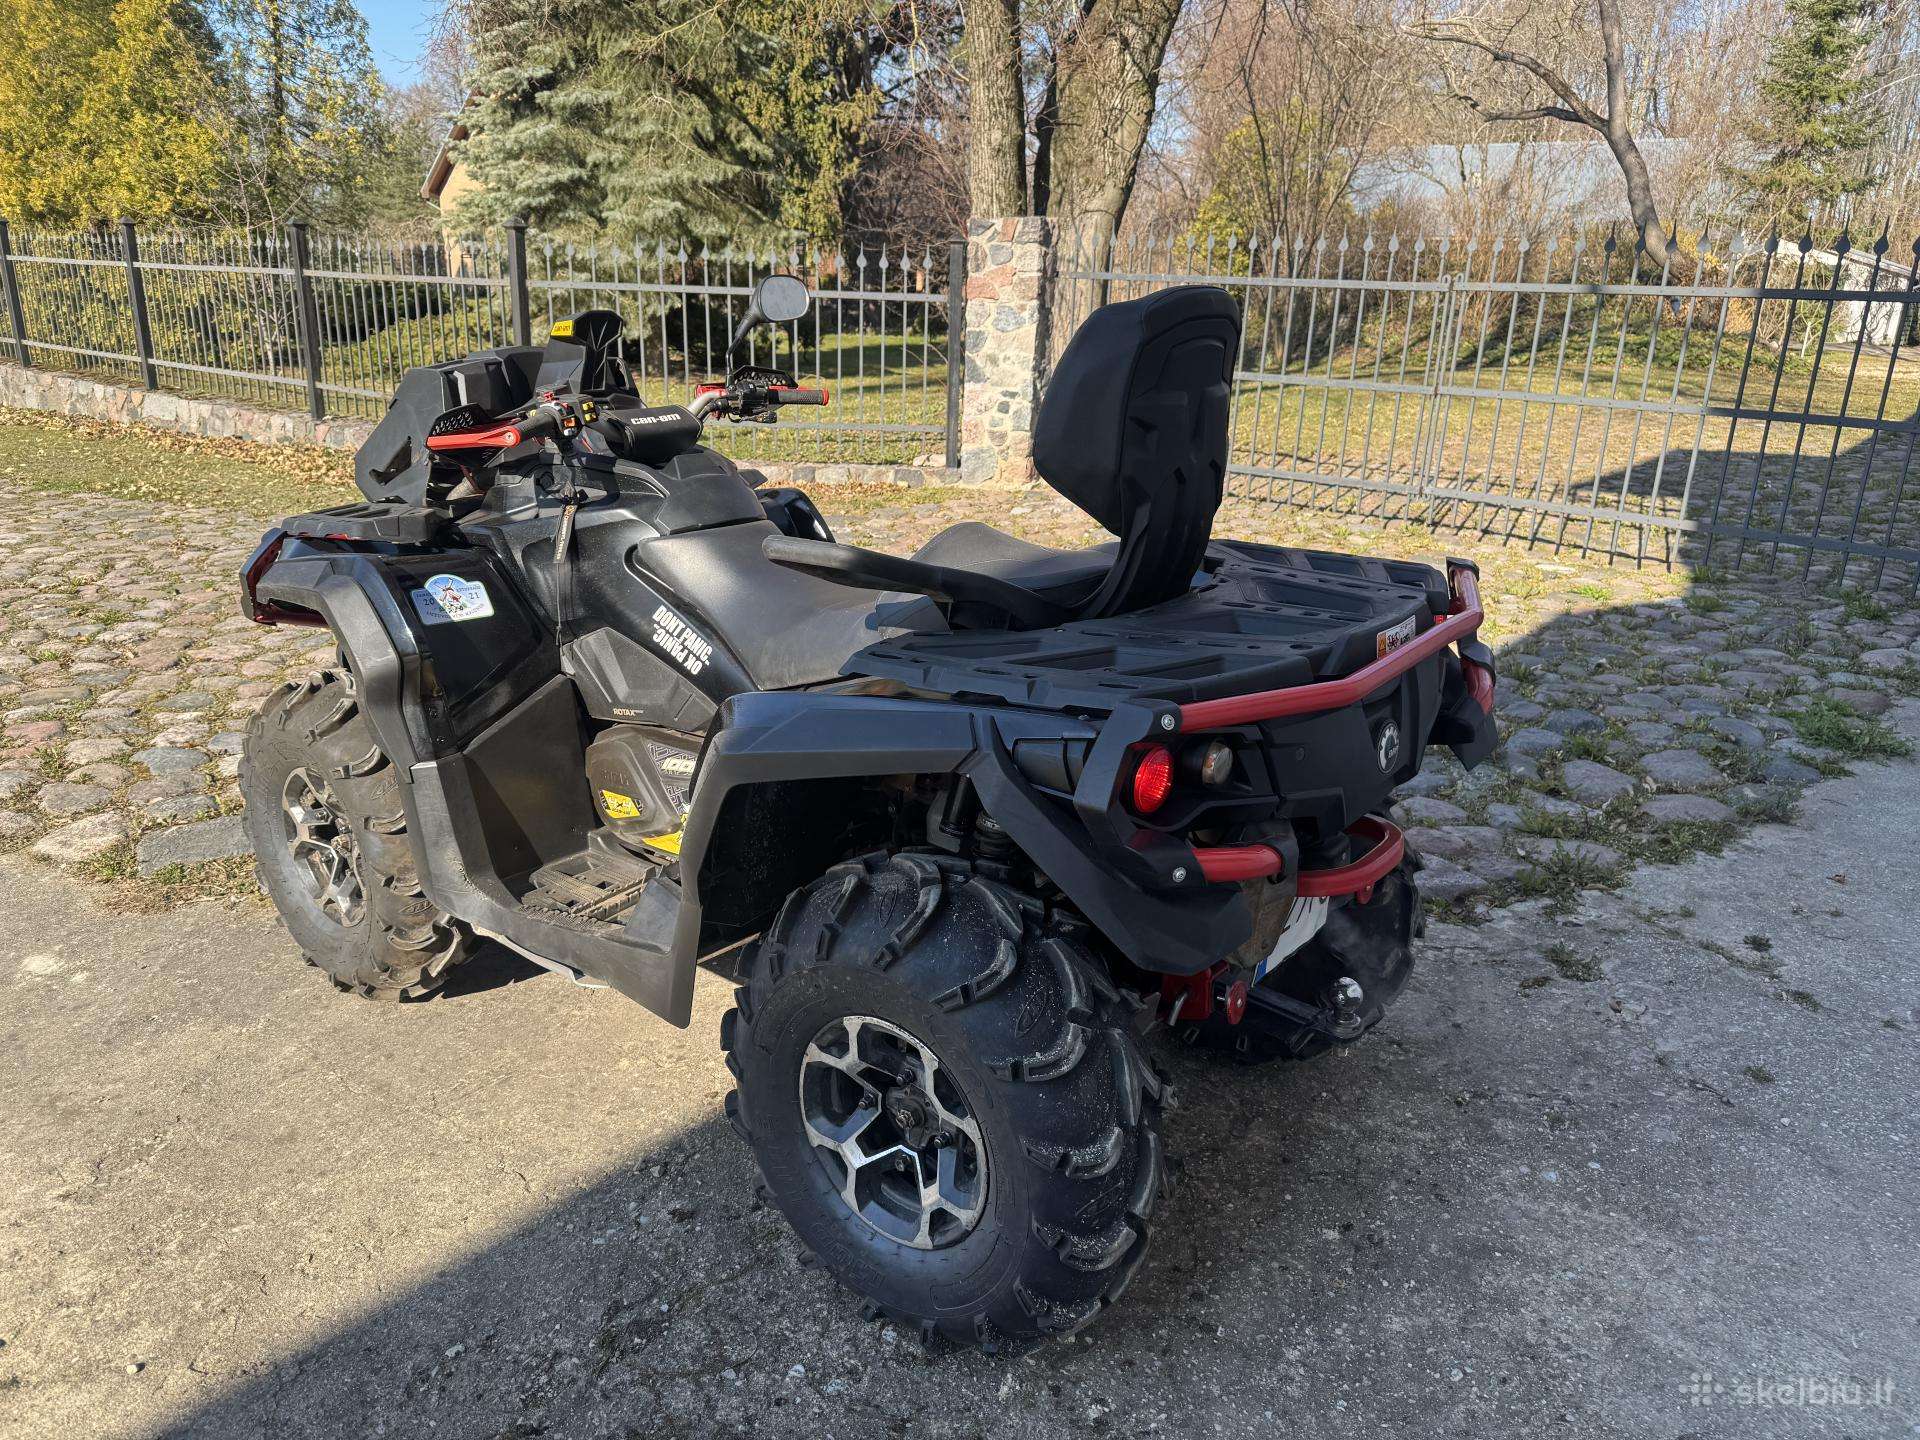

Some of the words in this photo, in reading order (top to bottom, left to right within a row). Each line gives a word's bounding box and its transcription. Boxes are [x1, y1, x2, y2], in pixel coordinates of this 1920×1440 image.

[631, 413, 681, 425] can-am
[423, 598, 435, 606] 20
[468, 592, 480, 600] 21
[683, 653, 703, 675] OK
